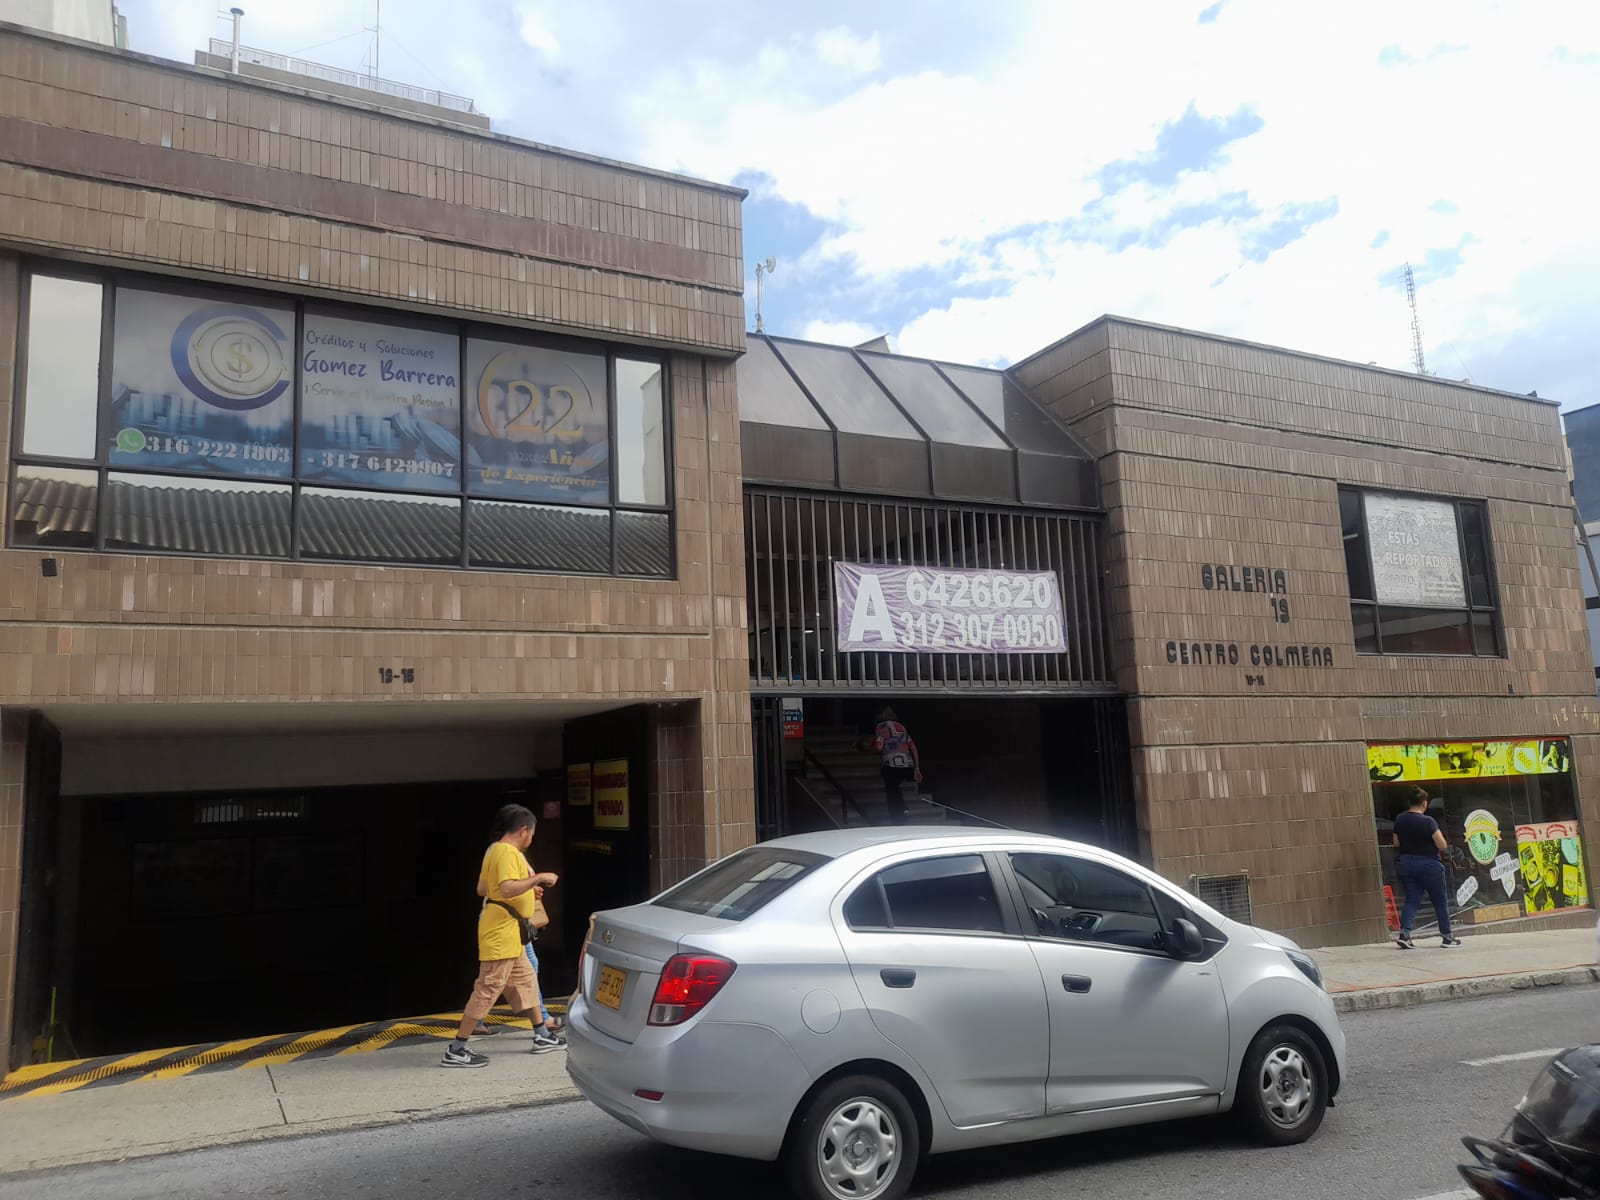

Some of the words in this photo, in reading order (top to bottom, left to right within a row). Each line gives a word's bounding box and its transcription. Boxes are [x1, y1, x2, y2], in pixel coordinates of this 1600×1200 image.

[306, 329, 354, 349] Créditos
[376, 339, 435, 360] Soluciones
[303, 350, 368, 378] Gomez
[380, 359, 456, 388] Barrera
[503, 380, 583, 438] 22
[146, 436, 190, 456] 316
[321, 452, 360, 469] 317
[544, 448, 594, 468] Añ
[905, 571, 1053, 609] 6426620
[1201, 564, 1286, 595] GALERIA
[847, 573, 897, 643] A
[1271, 597, 1290, 624] 19
[900, 611, 946, 648] 312
[953, 612, 996, 648] 307
[1003, 613, 1059, 648] 0950
[1166, 641, 1239, 666] CENTRO
[1250, 644, 1333, 667] COLMENA
